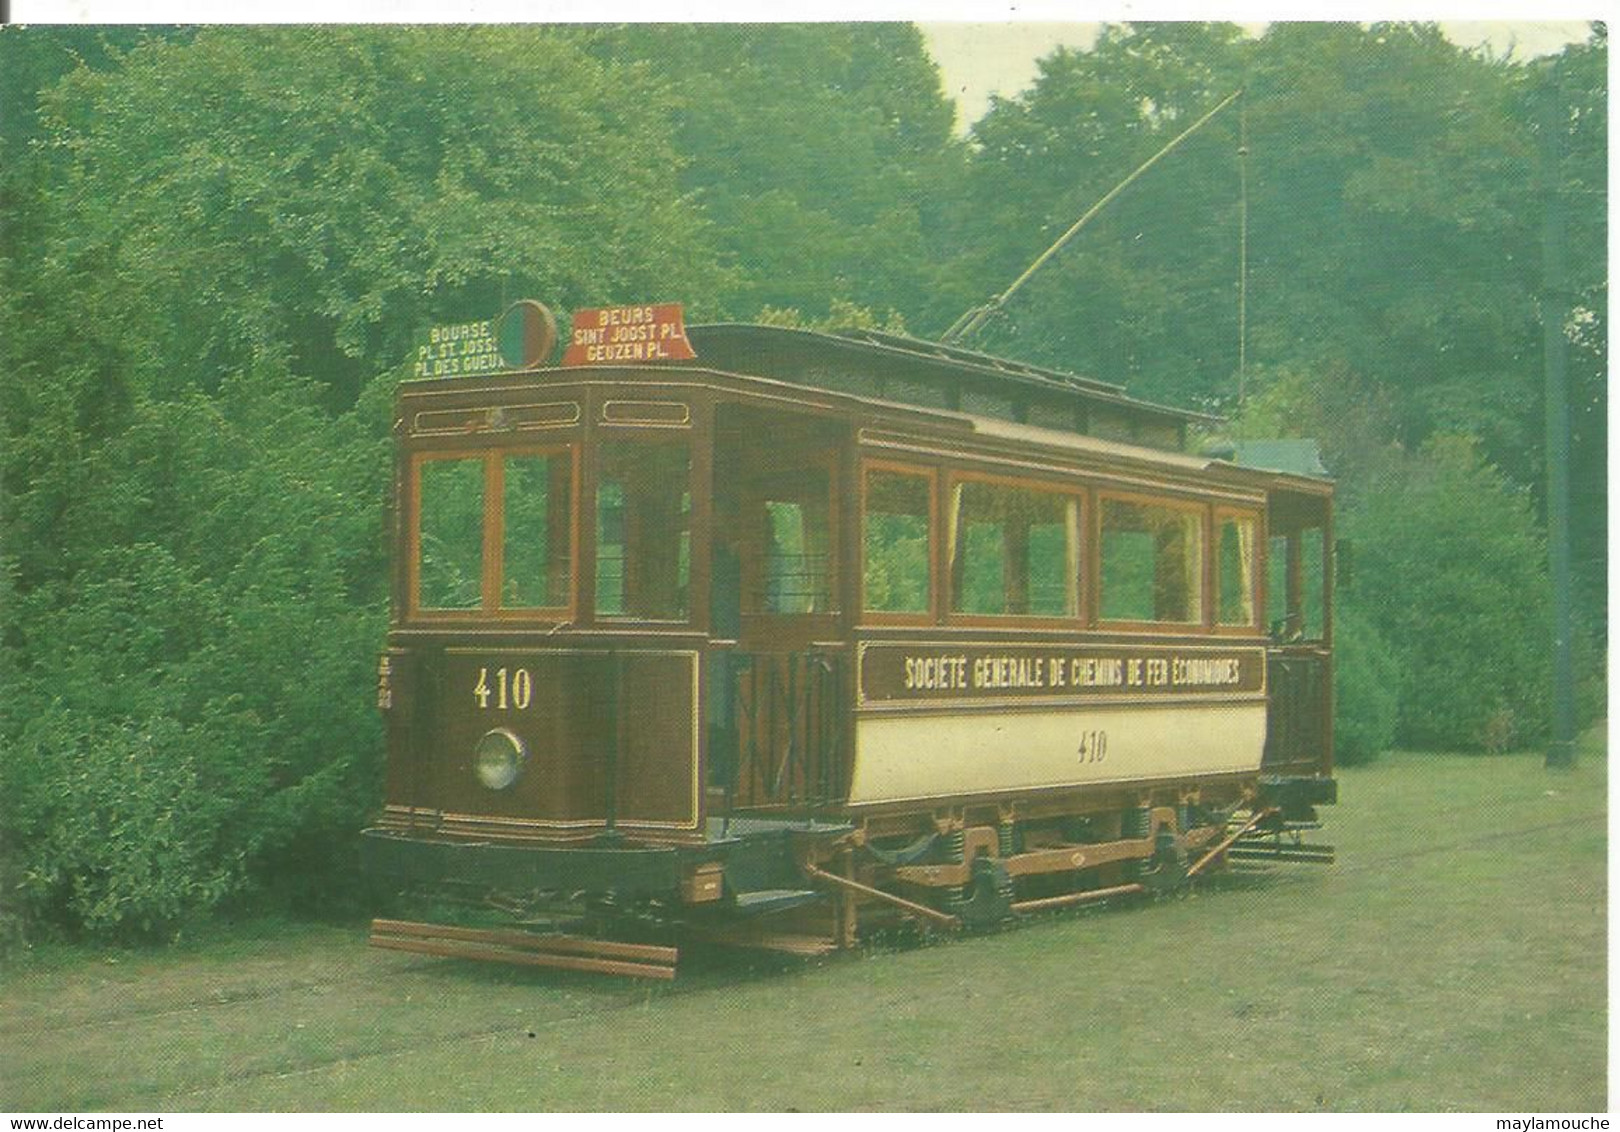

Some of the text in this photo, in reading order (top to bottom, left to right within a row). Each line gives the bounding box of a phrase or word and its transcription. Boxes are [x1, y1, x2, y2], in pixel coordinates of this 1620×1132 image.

[599, 306, 654, 327] BEURS
[430, 321, 490, 344] BOURSE
[574, 327, 607, 345] SINT
[610, 324, 657, 343] JOOST
[587, 343, 643, 361] GEUZEN
[434, 358, 460, 376] DES
[905, 654, 967, 688] SOCIÉTÉ
[974, 654, 1043, 688] GÉNÉRALE
[1050, 658, 1066, 687] DE
[1071, 658, 1122, 686] CHEMINS
[1127, 658, 1143, 686] DE
[1146, 658, 1168, 686] FER
[473, 667, 532, 710] 410
[1076, 730, 1107, 764] 410
